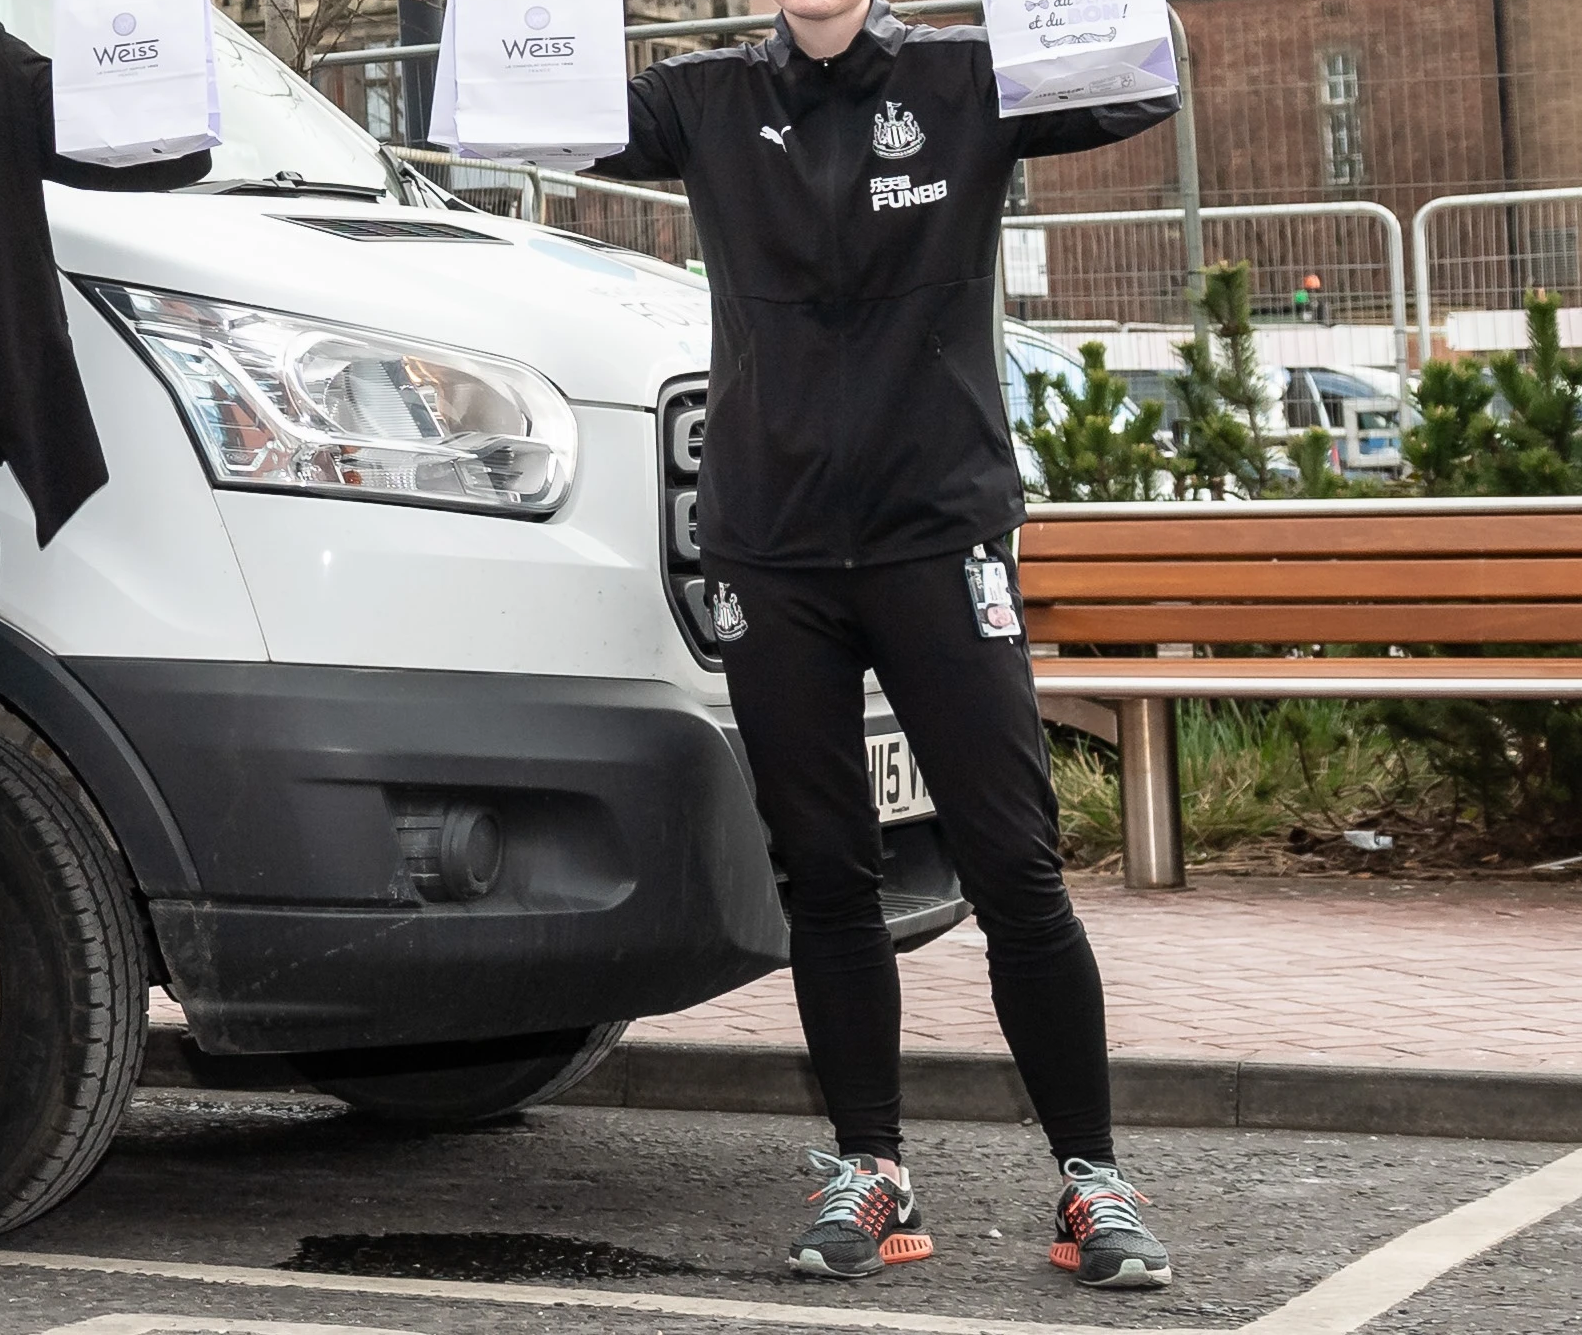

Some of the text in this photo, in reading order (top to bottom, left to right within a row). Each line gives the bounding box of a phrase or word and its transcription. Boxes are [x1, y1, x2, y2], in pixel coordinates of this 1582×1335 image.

[1028, 14, 1043, 31] et
[1046, 12, 1066, 28] du
[92, 39, 159, 66] Weiss
[502, 36, 576, 60] Weiss
[872, 179, 948, 212] FUN88
